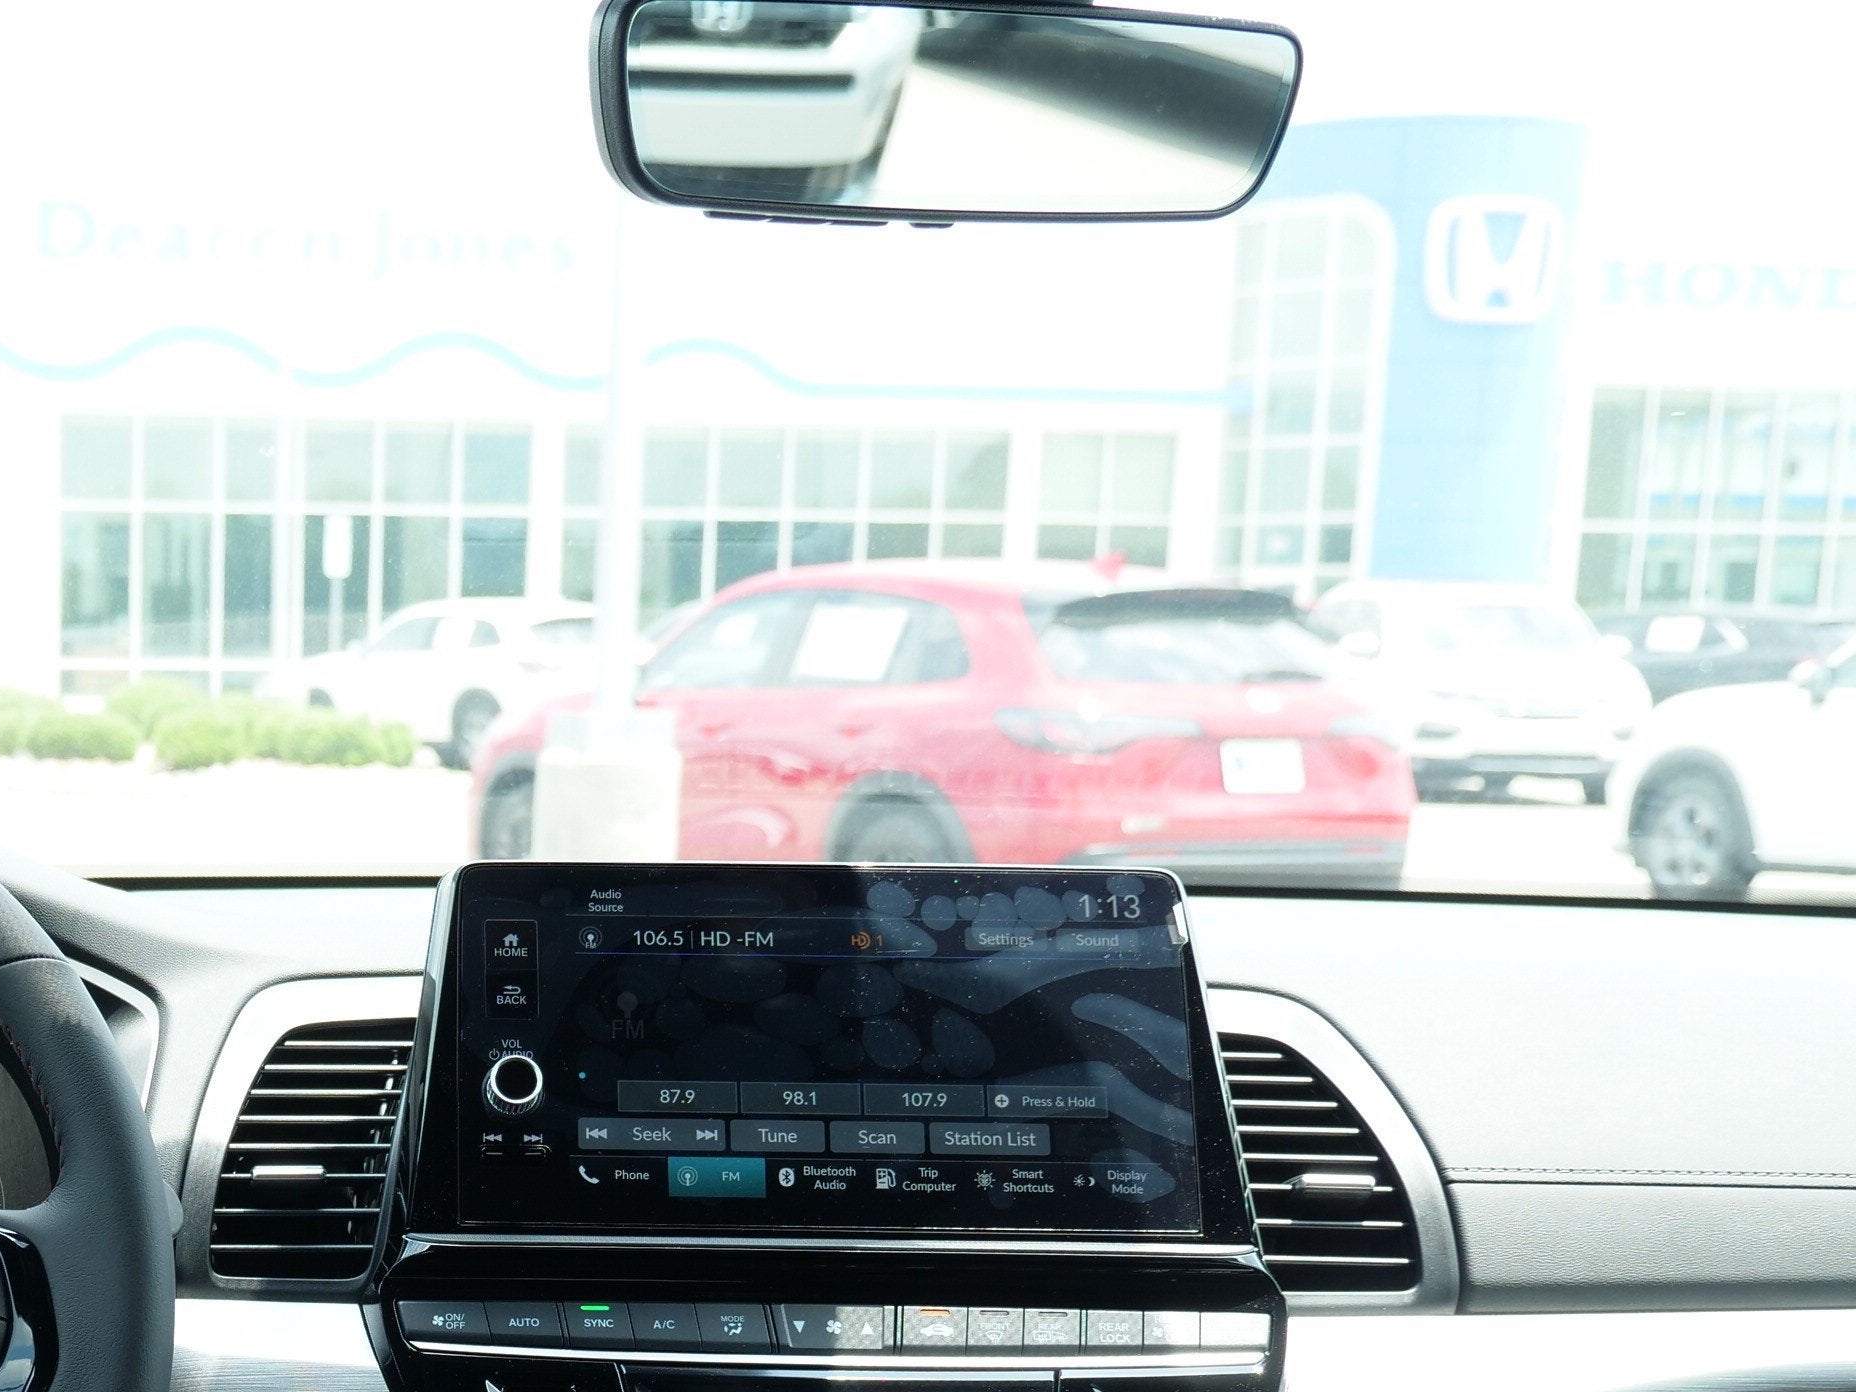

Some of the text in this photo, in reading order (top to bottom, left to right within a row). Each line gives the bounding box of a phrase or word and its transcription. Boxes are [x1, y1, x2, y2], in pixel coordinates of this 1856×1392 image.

[590, 889, 622, 900] Audio
[588, 902, 624, 913] Source
[1078, 895, 1141, 919] 1:13
[633, 930, 684, 946] 106.5
[700, 931, 731, 947] HD
[978, 933, 1034, 949] Settings
[1075, 934, 1119, 947] Sound
[494, 947, 528, 957] HOME
[496, 995, 527, 1005] BACK
[501, 1039, 522, 1049] VOL
[659, 1089, 695, 1104] 87.9
[782, 1091, 817, 1105] 98.1
[901, 1093, 947, 1107] 107.9
[1022, 1096, 1096, 1108] Press & Hold
[632, 1126, 672, 1142] Seek
[758, 1128, 798, 1144] Tune
[858, 1130, 897, 1145] Scan
[944, 1131, 1036, 1147] Station List
[615, 1169, 650, 1180] Phone
[722, 1171, 740, 1182] FM
[803, 1165, 856, 1177] Bluetooth
[918, 1167, 939, 1181] Trip
[1012, 1169, 1043, 1180] Smart
[1107, 1170, 1146, 1184] Display
[814, 1179, 846, 1190] Audio
[902, 1181, 956, 1194] Computer
[1003, 1182, 1054, 1193] Shortcuts
[1112, 1183, 1144, 1194] Mode
[445, 1313, 464, 1322] ON/
[508, 1318, 540, 1328] AUTO
[720, 1315, 744, 1323] MODE
[445, 1321, 466, 1330] OFF
[583, 1318, 614, 1329] SYNC
[653, 1319, 675, 1330] A/C
[979, 1322, 1010, 1330] FRONT
[1099, 1322, 1129, 1332] REAR
[1100, 1333, 1131, 1343] LOCK
